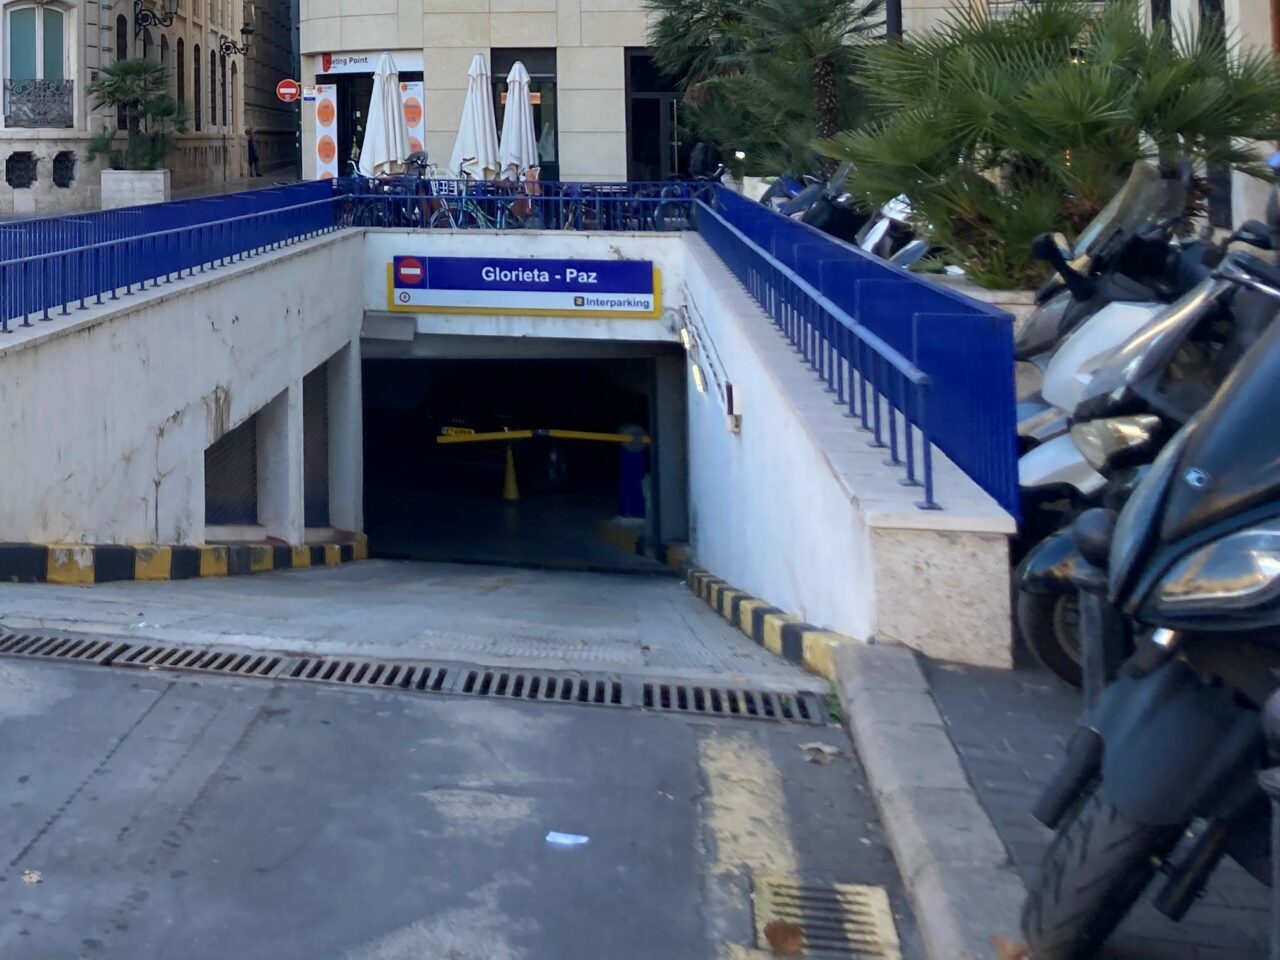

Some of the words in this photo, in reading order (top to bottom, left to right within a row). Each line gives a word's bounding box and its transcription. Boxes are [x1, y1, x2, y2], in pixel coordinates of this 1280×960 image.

[348, 56, 369, 65] Point
[481, 266, 550, 283] Glorieta
[566, 267, 598, 284] Paz
[585, 296, 650, 310] Interparking
